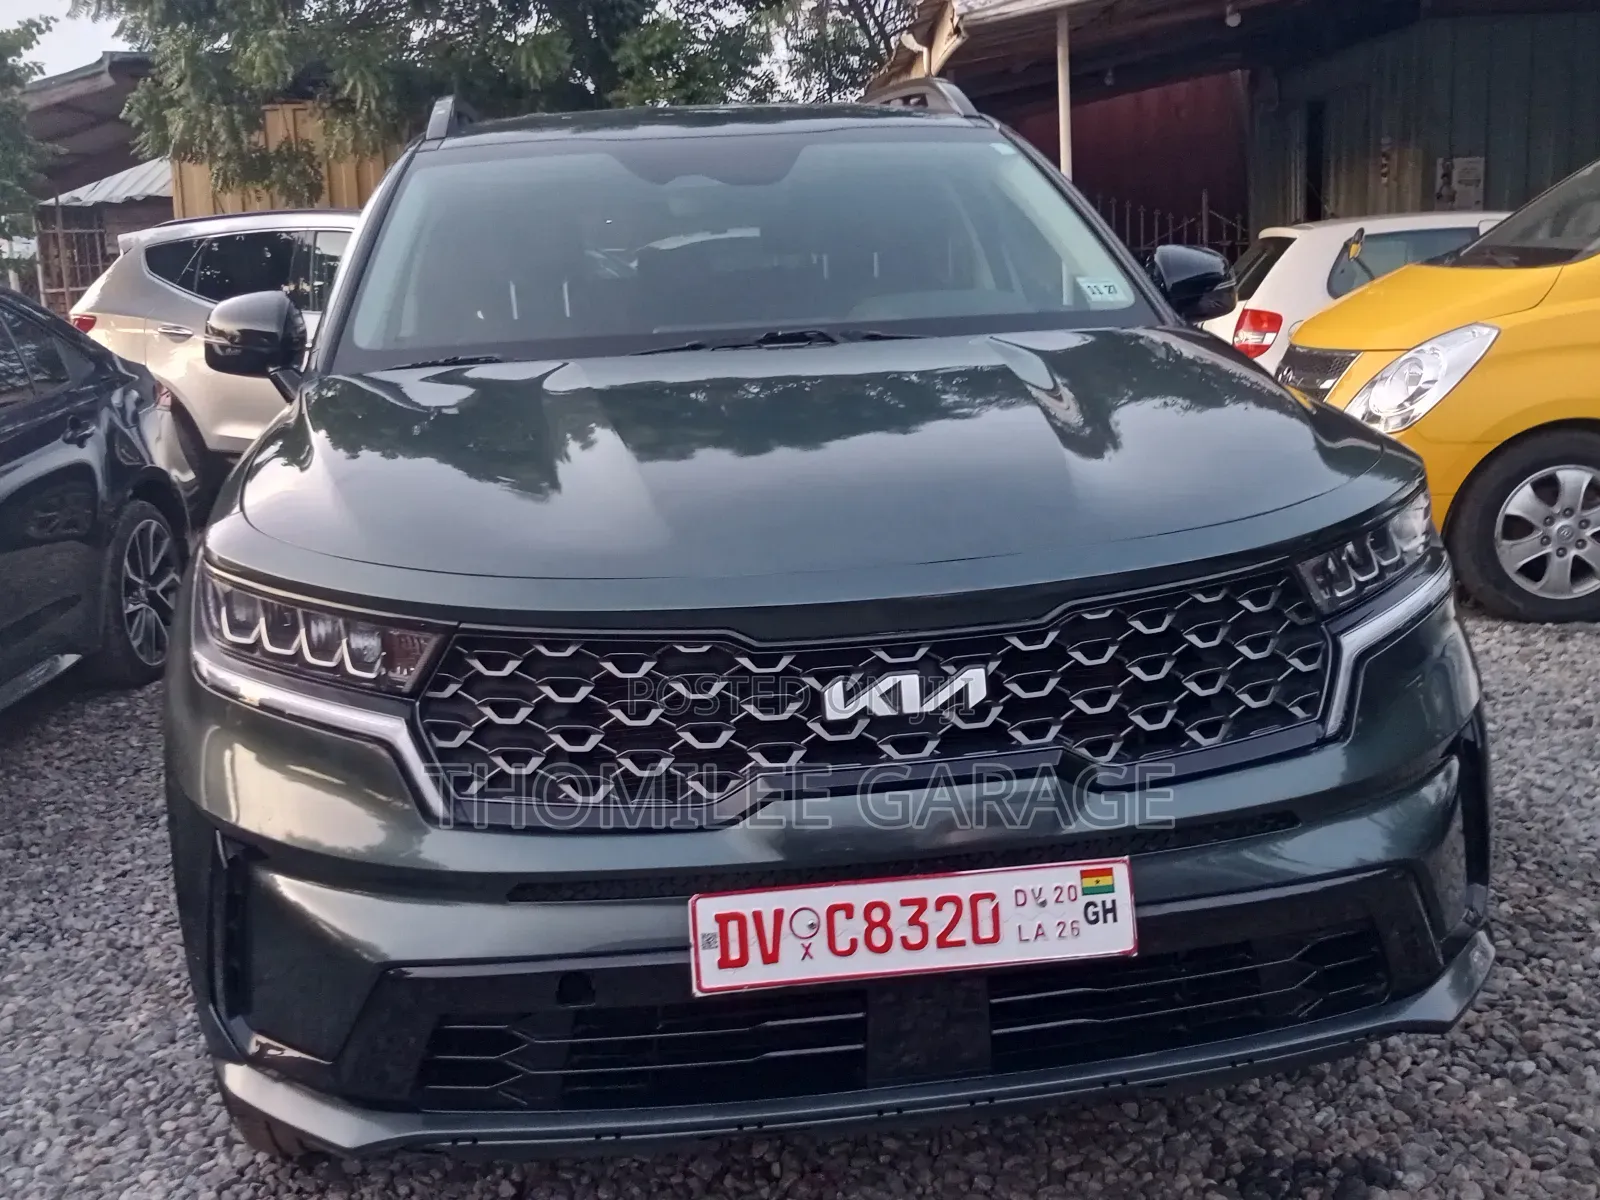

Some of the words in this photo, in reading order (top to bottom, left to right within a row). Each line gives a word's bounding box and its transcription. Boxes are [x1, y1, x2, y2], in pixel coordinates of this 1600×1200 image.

[1053, 884, 1077, 903] 20
[1083, 898, 1118, 925] GH
[714, 908, 784, 969] DV
[825, 892, 1001, 957] C8320
[1017, 921, 1046, 943] LA
[1055, 919, 1081, 940] 26
